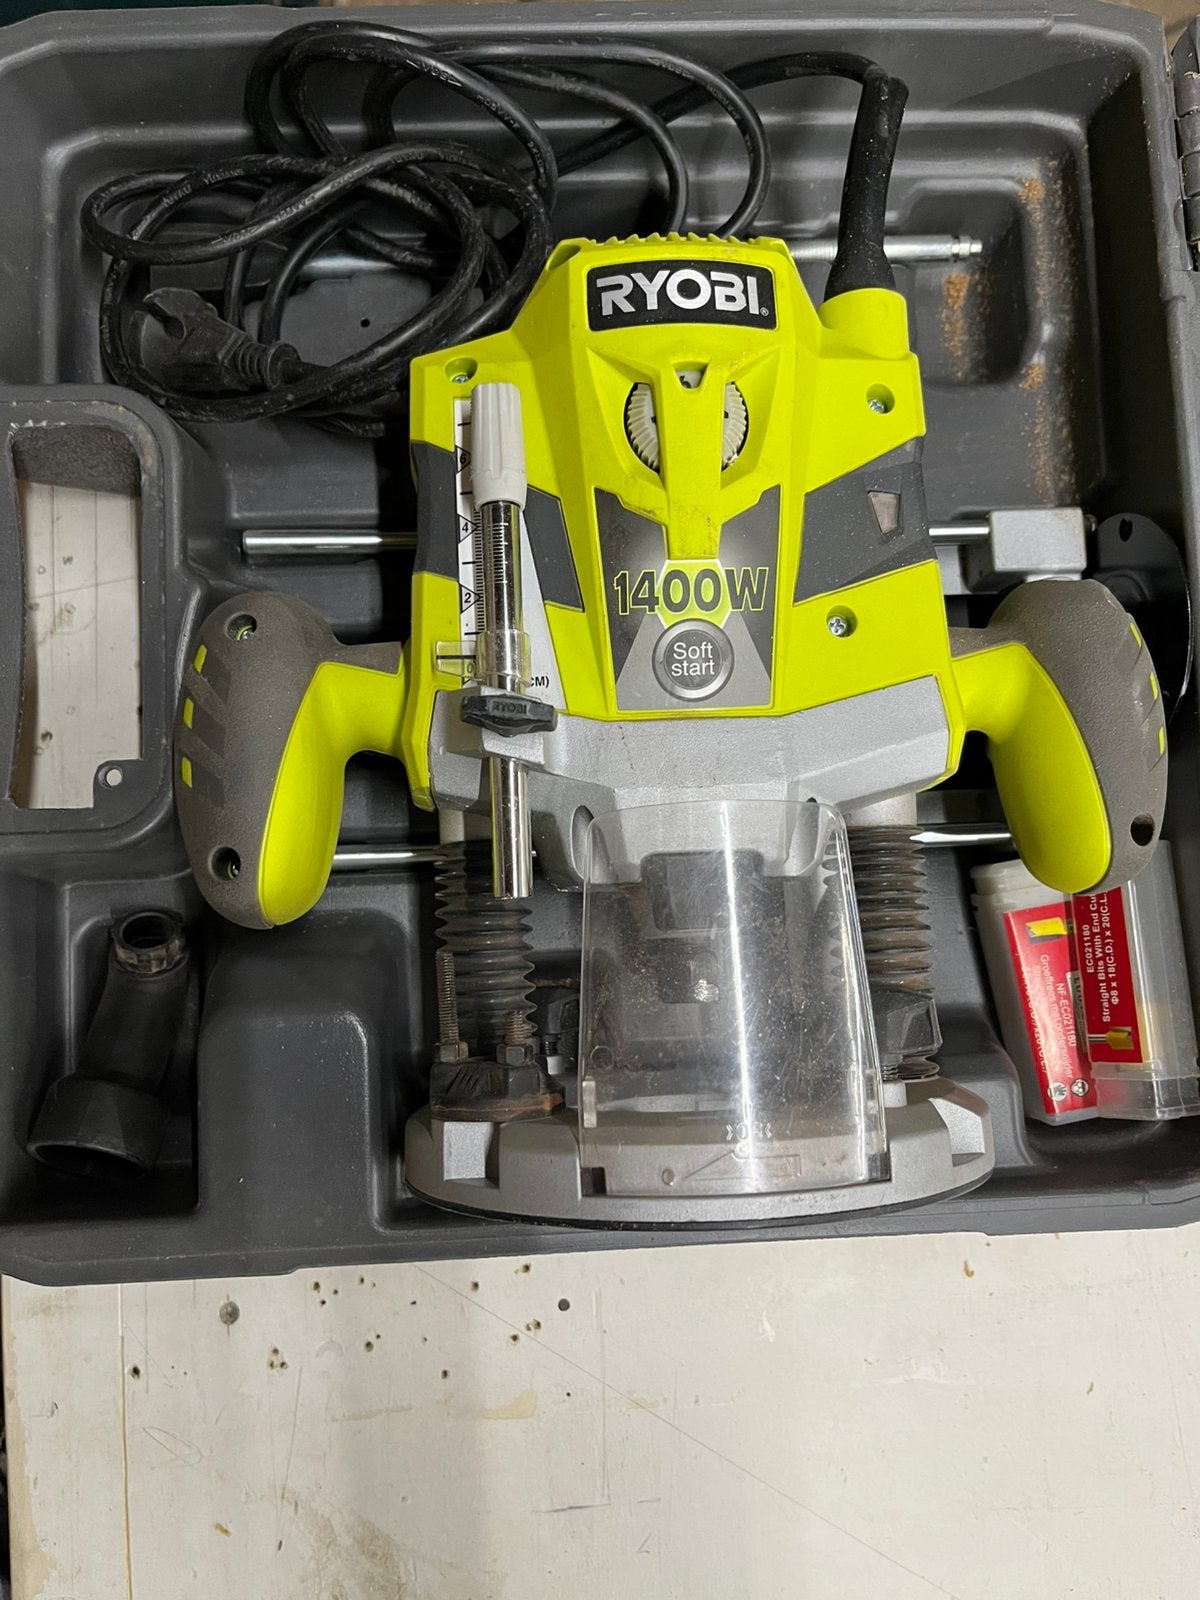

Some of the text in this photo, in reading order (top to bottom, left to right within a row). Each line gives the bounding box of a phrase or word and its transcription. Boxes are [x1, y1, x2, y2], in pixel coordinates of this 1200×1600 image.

[596, 269, 760, 316] RYOBI
[459, 452, 467, 465] 6
[461, 521, 469, 533] 4
[463, 592, 472, 604] 2
[613, 566, 770, 616] 1400W
[673, 641, 713, 660] Soft
[671, 659, 716, 677] start
[1090, 913, 1101, 933] End
[1081, 923, 1095, 974] EC021180
[1093, 935, 1103, 958] With
[1096, 960, 1106, 980] Bits
[1098, 982, 1111, 1022] Straight
[1056, 982, 1078, 1047] NF-EC021180
